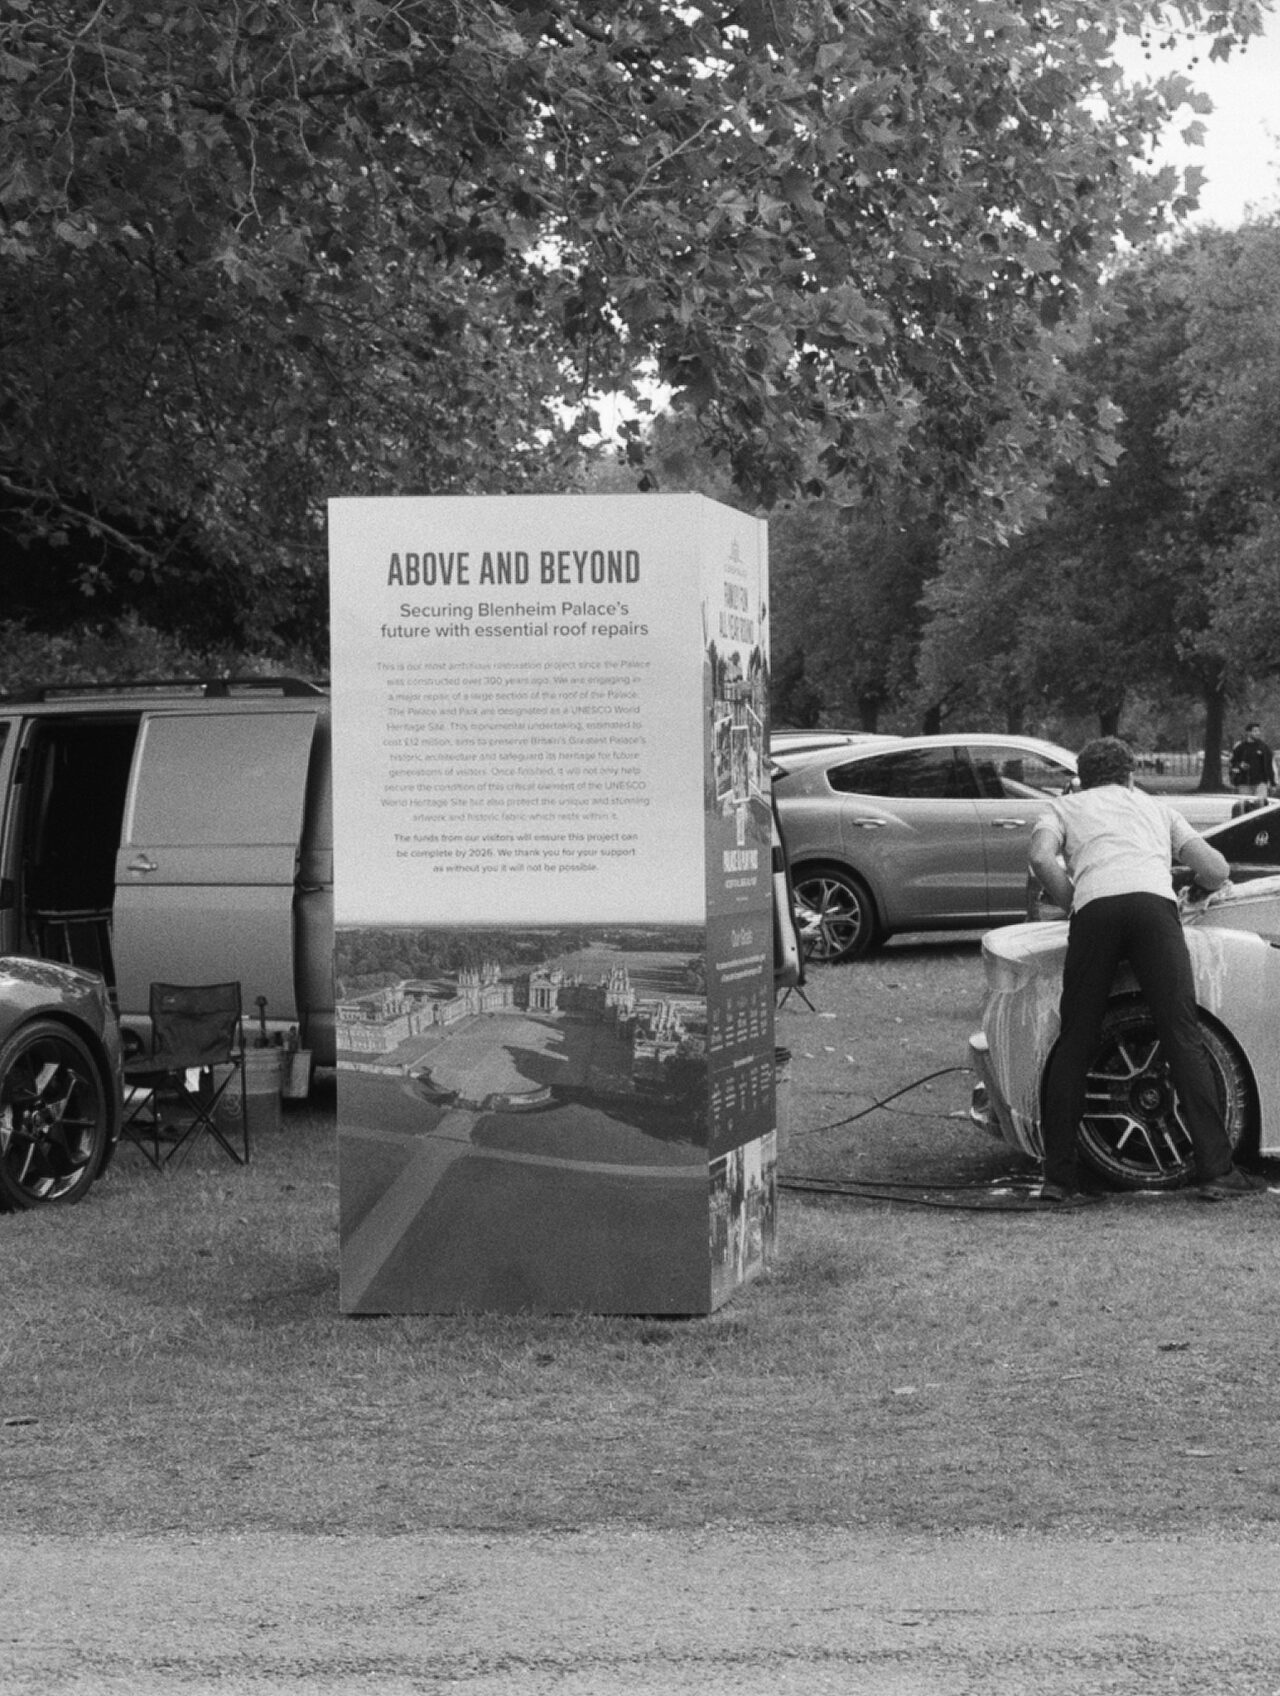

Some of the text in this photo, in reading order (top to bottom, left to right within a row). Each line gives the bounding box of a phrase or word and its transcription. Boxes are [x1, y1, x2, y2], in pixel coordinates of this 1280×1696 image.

[387, 550, 639, 586] ABOVE AND BEYOND
[400, 601, 629, 620] Securing Blenheim Palace's
[381, 621, 648, 638] future with essential roof repairs
